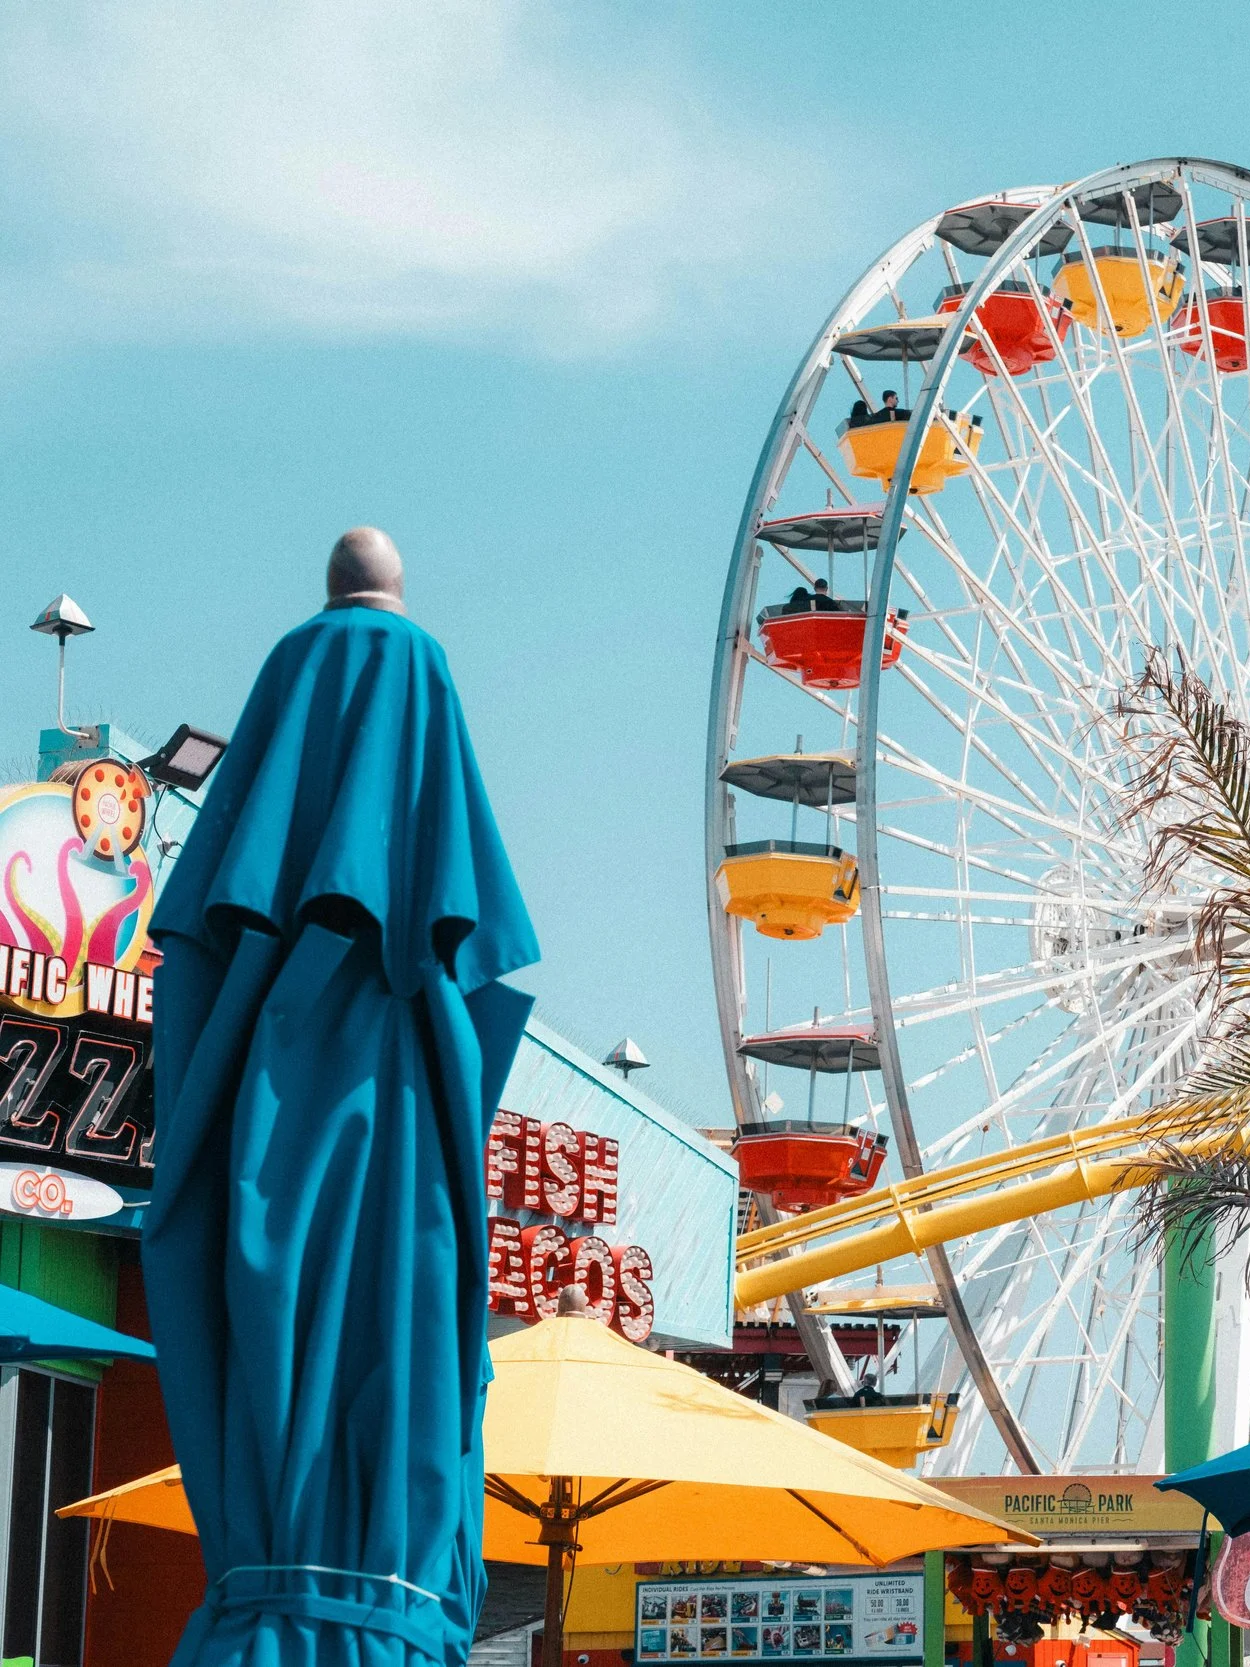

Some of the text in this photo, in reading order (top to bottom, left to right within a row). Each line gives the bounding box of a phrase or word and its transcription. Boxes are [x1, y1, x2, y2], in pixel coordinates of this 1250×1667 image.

[0, 1014, 155, 1167] ZZ
[484, 1109, 619, 1226] FISH
[13, 1169, 73, 1214] CO.
[1005, 1494, 1133, 1512] PACIFIC PARK
[1030, 1516, 1110, 1525] SANTA MONICA PIER
[880, 1587, 914, 1595] WRISTBAND
